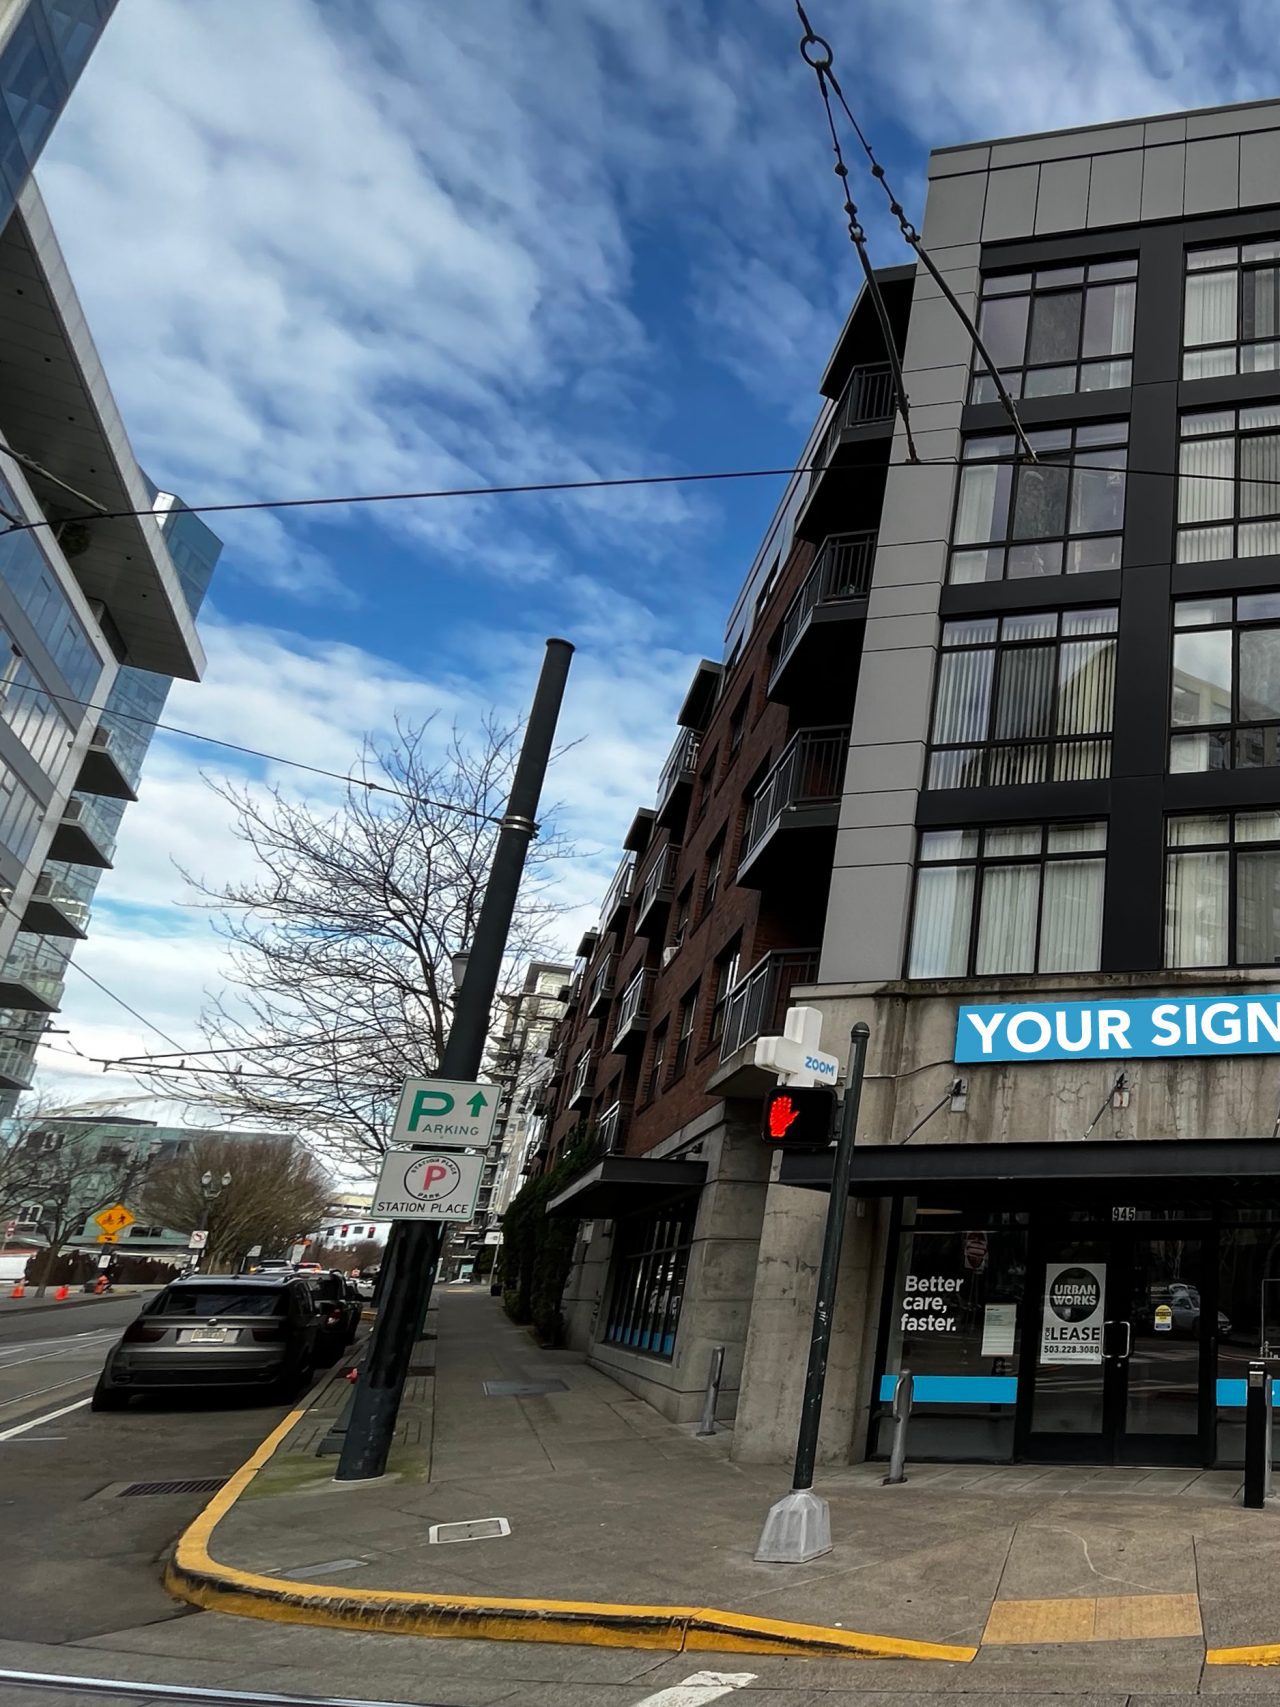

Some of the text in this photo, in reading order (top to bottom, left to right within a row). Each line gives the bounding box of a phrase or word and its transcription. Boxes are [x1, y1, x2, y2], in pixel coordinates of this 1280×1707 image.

[967, 1009, 1133, 1054] YOUR
[805, 1056, 835, 1077] ZOOM
[407, 1090, 480, 1136] PARKING
[423, 1165, 447, 1191] P
[377, 1202, 469, 1214] STATION PLACE
[1113, 1207, 1135, 1220] 945
[905, 1275, 964, 1292] Better
[1054, 1284, 1097, 1295] URBAN
[902, 1296, 948, 1314] care,
[1052, 1295, 1097, 1306] WORKS
[900, 1313, 957, 1331] faster.
[1051, 1327, 1100, 1341] LEASE
